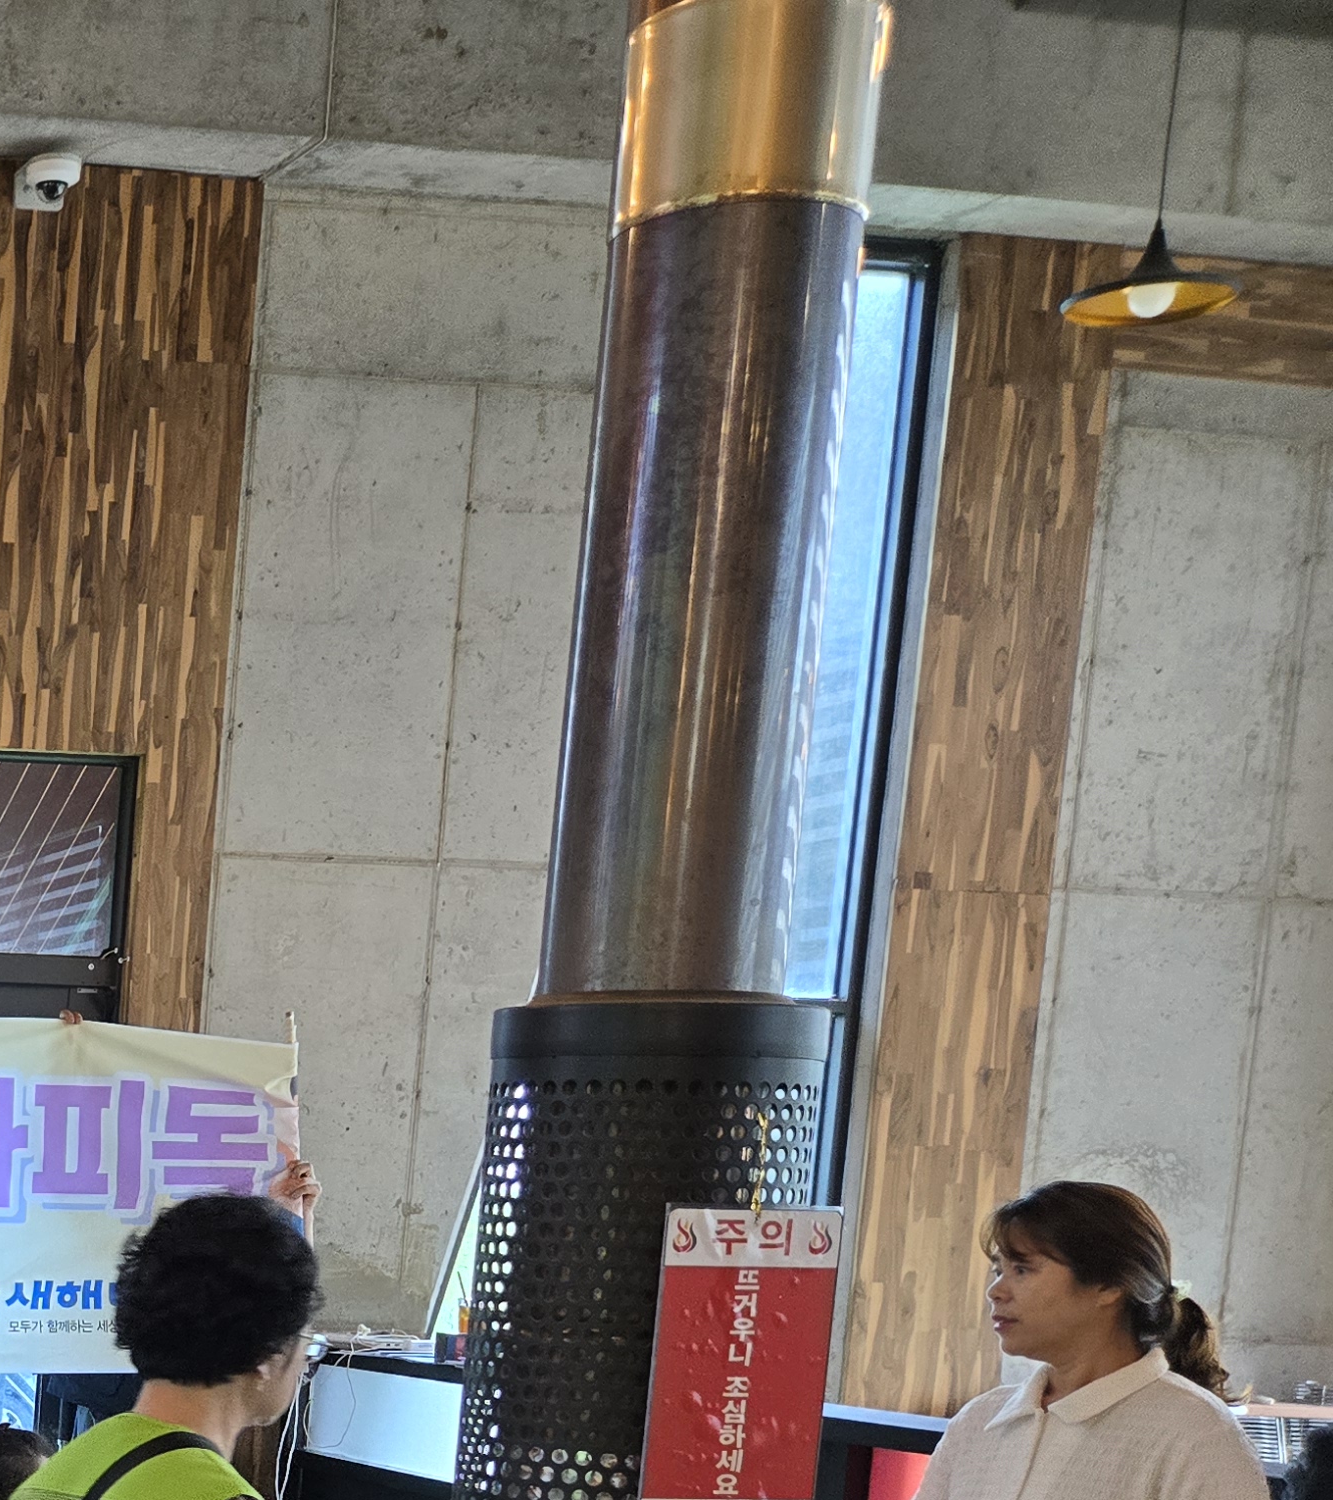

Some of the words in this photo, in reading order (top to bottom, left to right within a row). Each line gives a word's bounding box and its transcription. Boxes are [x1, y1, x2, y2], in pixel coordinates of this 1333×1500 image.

[714, 1218, 794, 1257] 주의
[5, 1279, 121, 1311] 새해
[8, 1319, 43, 1334] 모두가
[46, 1319, 94, 1334] 함께하는
[728, 1270, 761, 1368] 뜨거우니
[712, 1376, 749, 1496] 조심하세요
